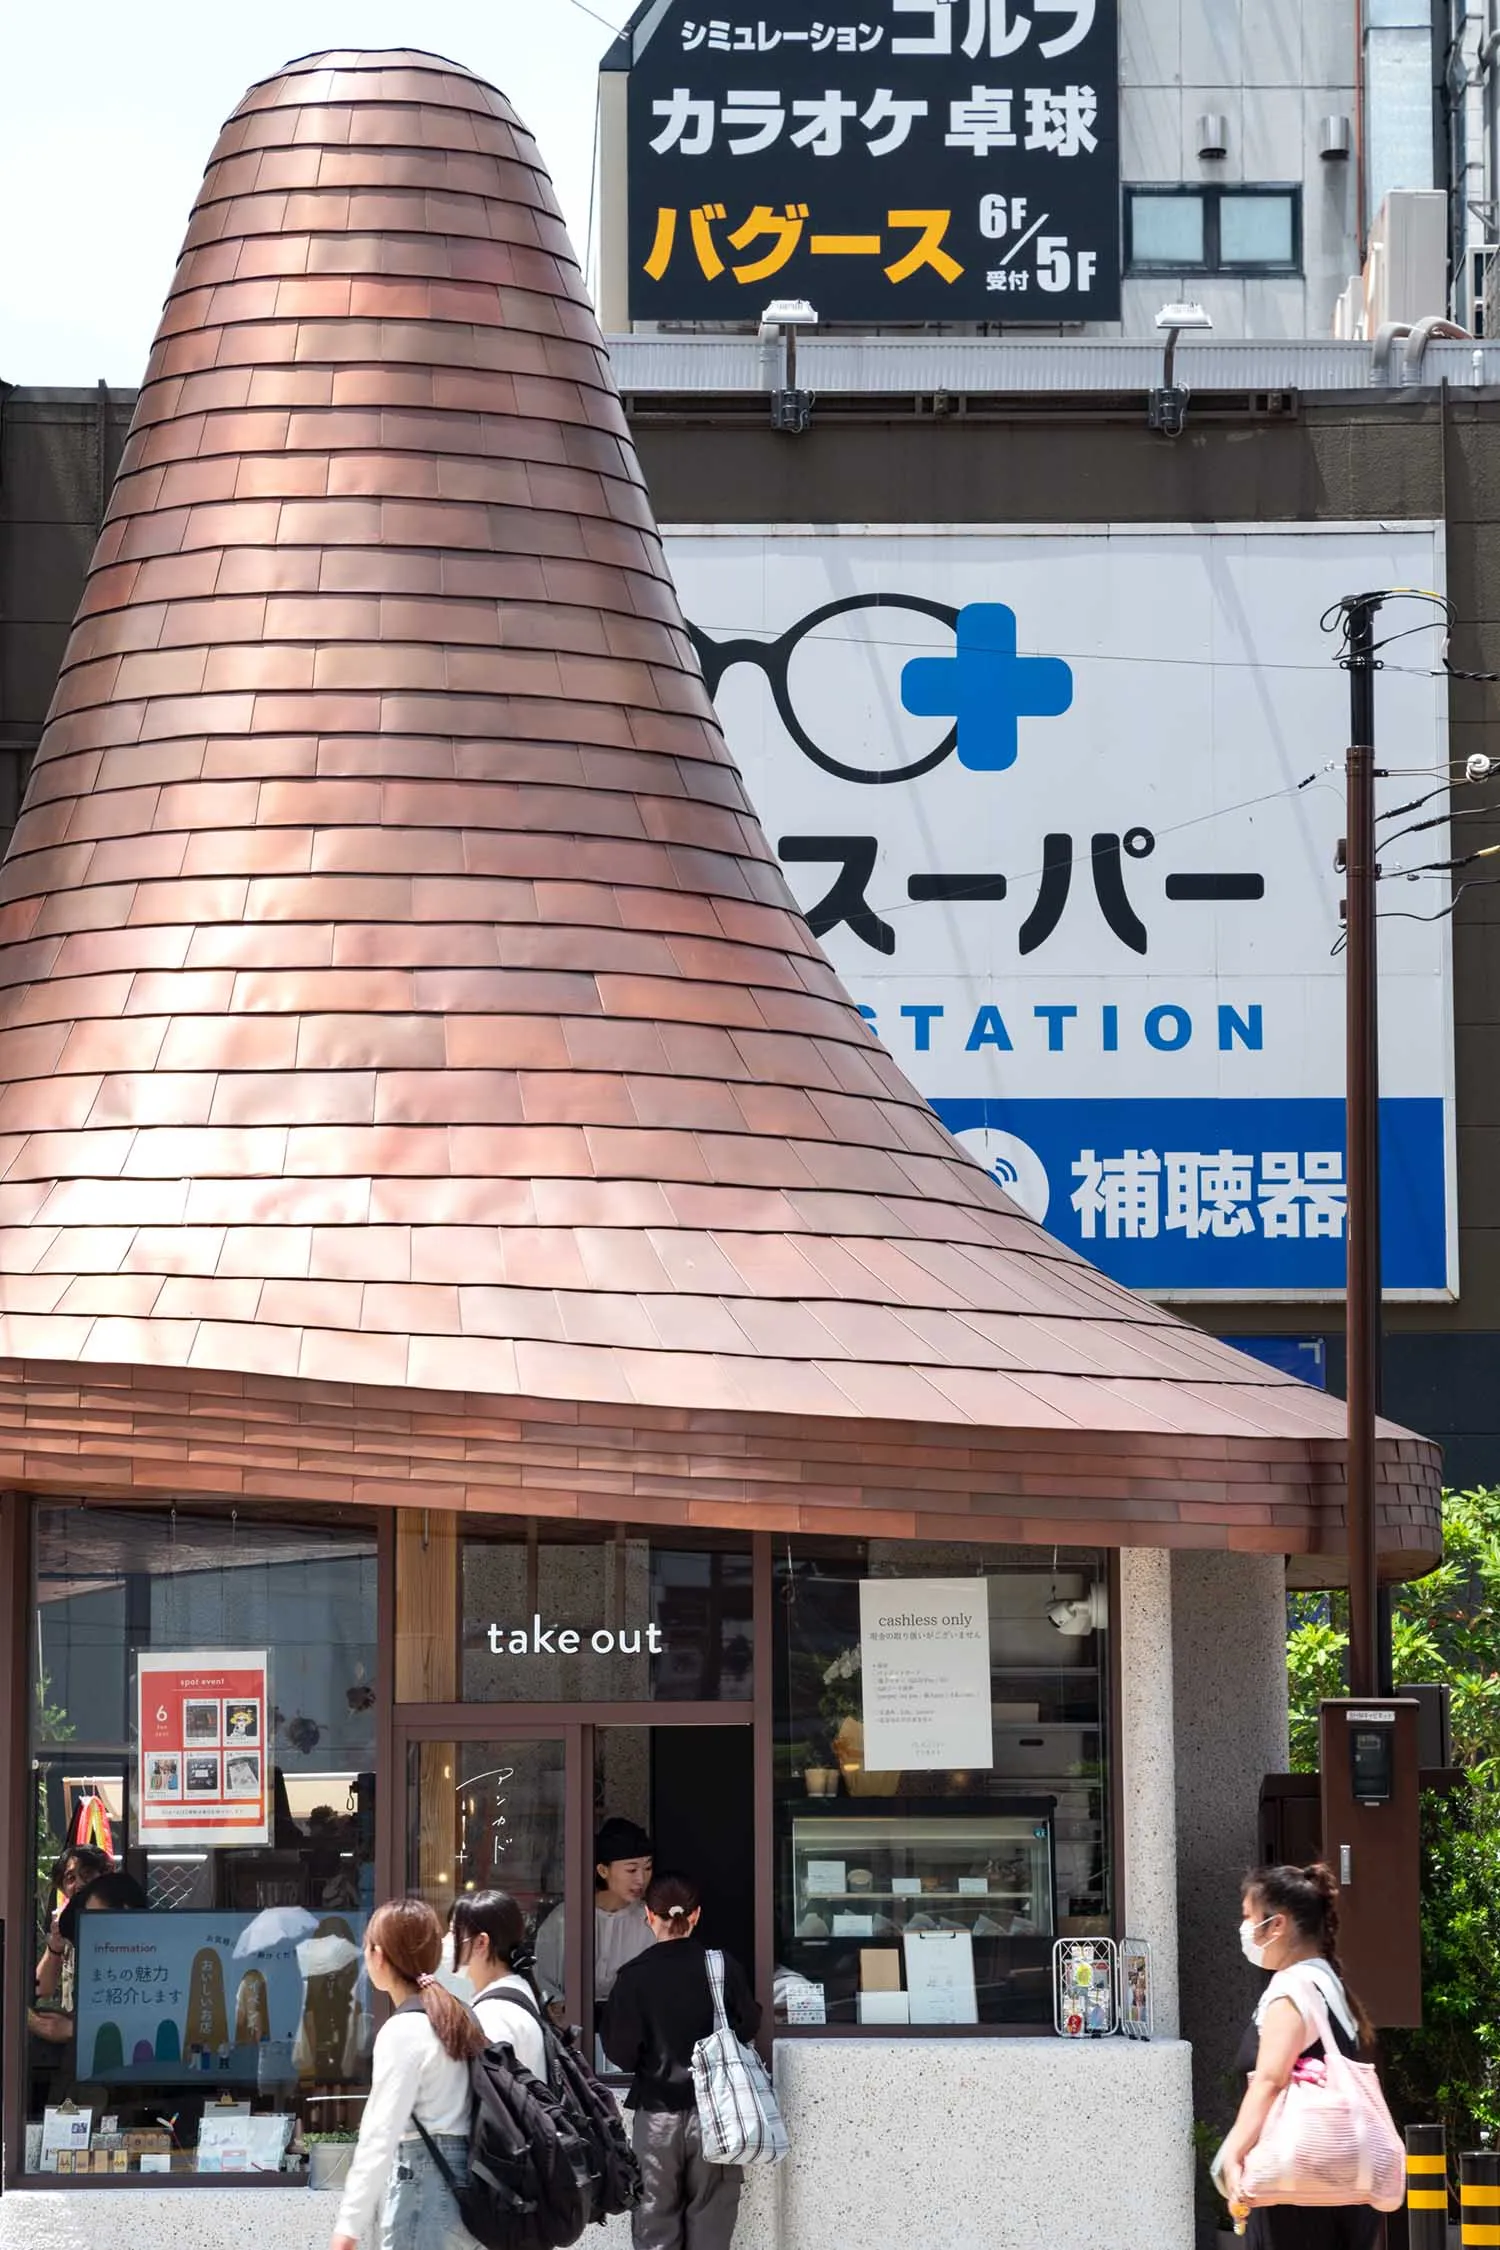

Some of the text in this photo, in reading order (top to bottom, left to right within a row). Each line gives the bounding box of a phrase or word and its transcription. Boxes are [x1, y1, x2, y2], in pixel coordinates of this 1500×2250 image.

[681, 0, 1096, 59] シミュレーション ゴルフ
[649, 85, 1099, 157] カラオケ 卓球
[979, 193, 1028, 239] 6F
[643, 203, 965, 284] バグース
[986, 236, 1097, 292] 受付 5F
[777, 827, 1265, 956] スーパー
[1070, 1148, 1346, 1239] 補聴器
[487, 1614, 662, 1654] take out
[878, 1612, 973, 1628] cashless only
[180, 1678, 199, 1687] spot
[156, 1705, 168, 1722] 6
[94, 1942, 157, 1954] information
[91, 1986, 183, 2006] ご紹介します
[92, 1965, 169, 1983] まちの魅力
[200, 1960, 214, 2035] おいしいお店
